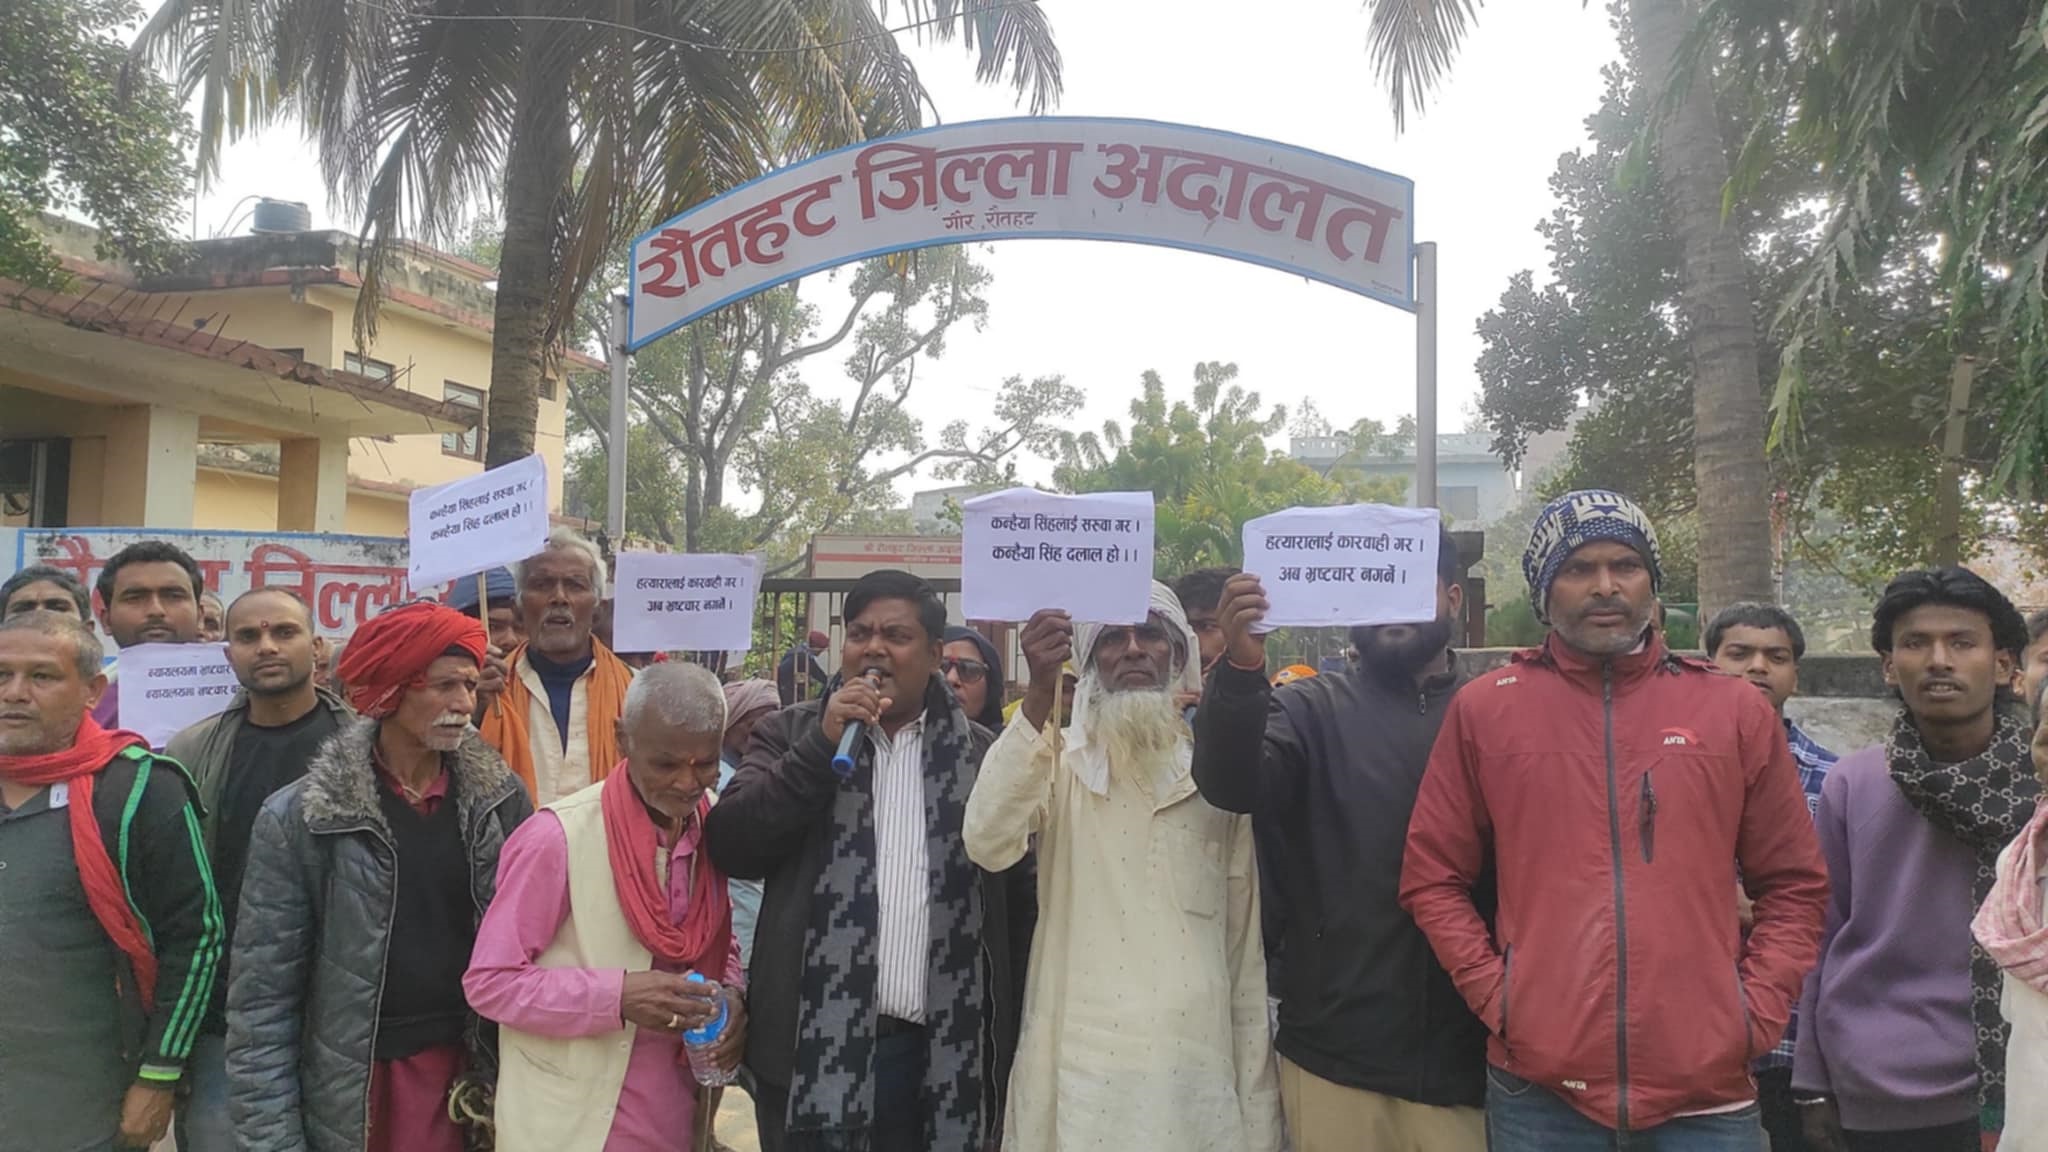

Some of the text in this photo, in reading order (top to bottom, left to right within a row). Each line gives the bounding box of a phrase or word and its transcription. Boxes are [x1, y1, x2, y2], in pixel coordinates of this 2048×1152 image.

[638, 143, 1403, 297] रौतहट जिल्ला अदालत
[991, 512, 1031, 531] कन्हैया
[1115, 519, 1132, 533] गर
[1265, 531, 1334, 551] हत्यारालाई
[1337, 531, 1390, 552] कारवाही
[1394, 537, 1414, 552] गर
[992, 542, 1035, 561] कन्हैया
[1039, 542, 1062, 562] सिंह
[1066, 547, 1102, 562] दलाल
[1106, 544, 1119, 563] हो
[1279, 566, 1300, 581] अब
[1663, 736, 1686, 745] ANTA
